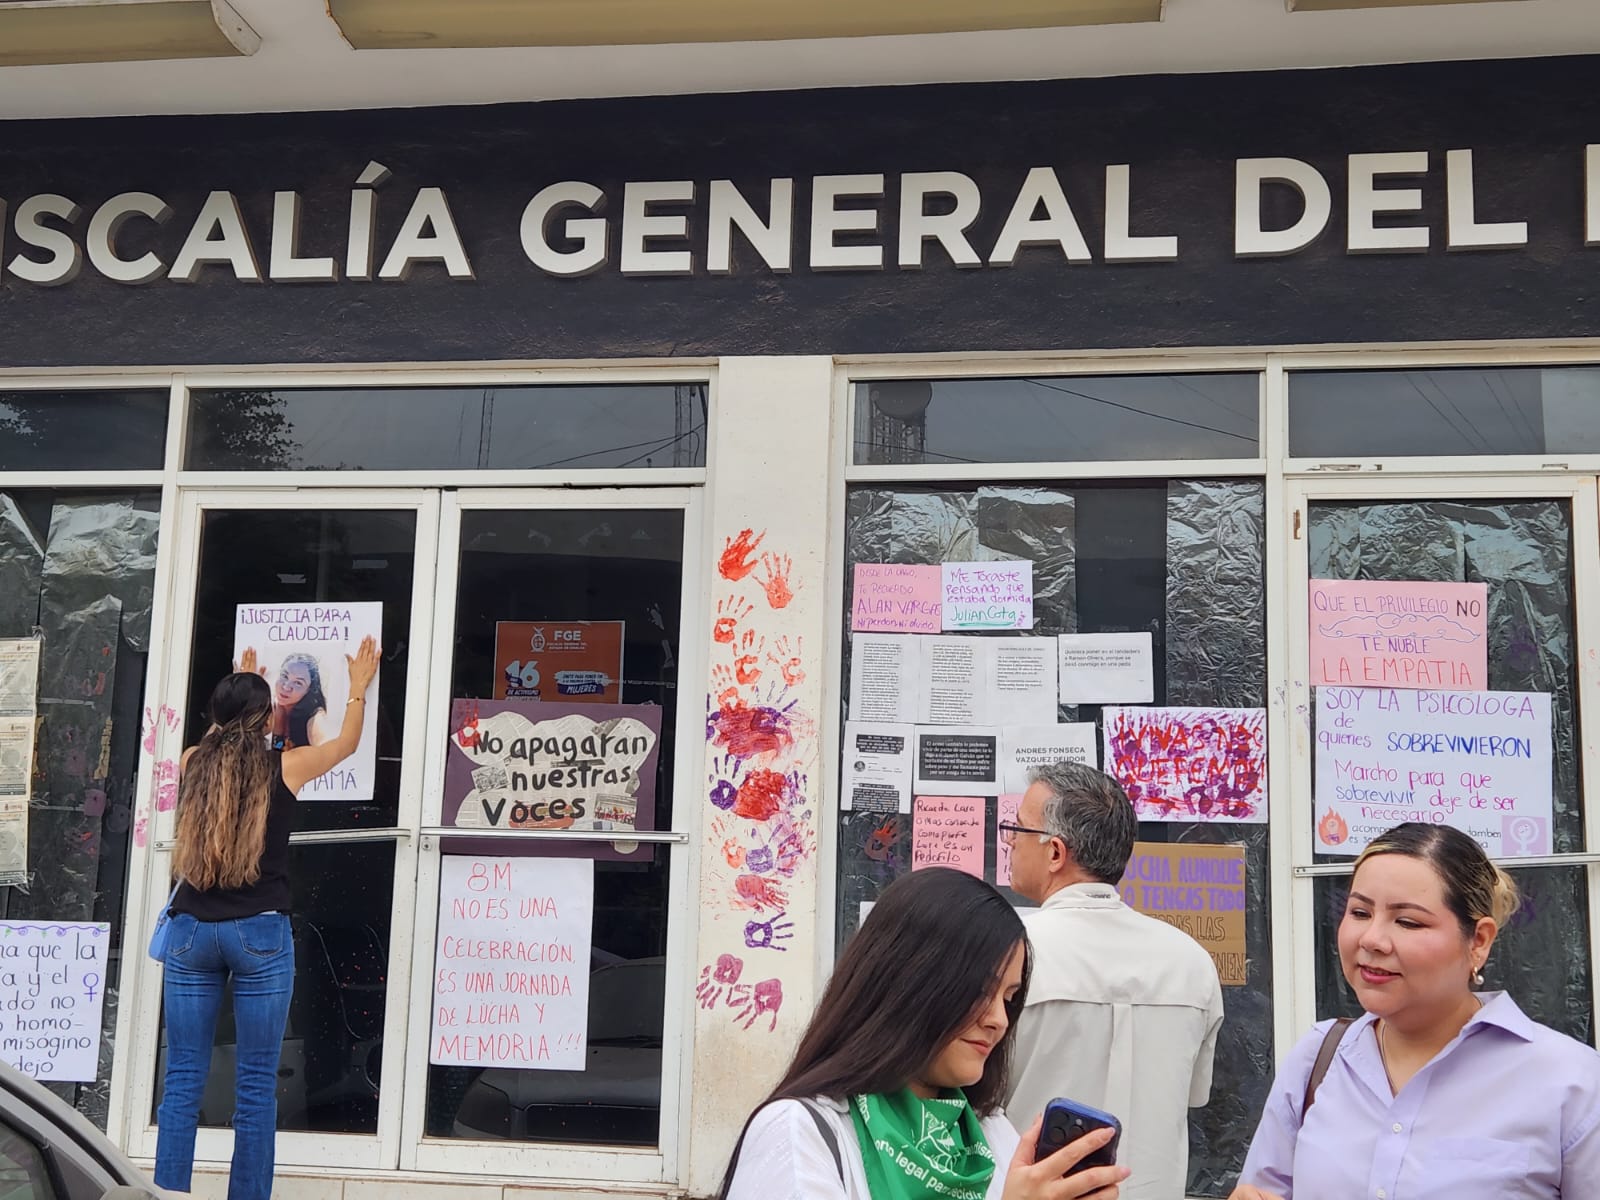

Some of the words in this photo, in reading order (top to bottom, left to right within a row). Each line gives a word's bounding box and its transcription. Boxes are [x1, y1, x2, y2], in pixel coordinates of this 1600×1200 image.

[0, 160, 475, 286] SCALÍA
[520, 163, 1179, 280] GENERAL
[1234, 148, 1528, 259] DEL
[315, 608, 351, 623] PARA
[858, 598, 892, 614] ALAN
[1314, 590, 1346, 612] QUE
[1354, 596, 1374, 612] EL
[1376, 595, 1448, 614] PRIVILEGIO
[1456, 600, 1481, 617] NO
[268, 626, 339, 641] CLAUDIA
[554, 631, 581, 641] FGE
[1357, 636, 1384, 651] TE
[1388, 638, 1431, 653] NUBLE
[505, 660, 540, 688] 16
[1322, 656, 1352, 683] LA
[1363, 656, 1472, 686] EMPATIA
[1326, 689, 1364, 711] SOY
[1378, 688, 1400, 712] LA
[1334, 712, 1355, 729] de
[474, 731, 503, 755] No
[1318, 731, 1371, 751] quienes
[1387, 732, 1531, 759] SOBREVIVIERON
[512, 765, 631, 791] nuestras
[1335, 759, 1398, 782] Marcho
[1409, 770, 1445, 790] para
[1460, 772, 1492, 793] que
[1335, 784, 1416, 805] sobrevivir
[1429, 790, 1461, 813] deje
[1469, 793, 1487, 810] de
[1493, 796, 1518, 811] ser
[1361, 806, 1445, 823] necesario
[467, 862, 512, 892] 8M
[453, 898, 481, 919] NO
[486, 898, 509, 919] ES
[520, 897, 558, 919] UNA
[1197, 916, 1226, 942] LAS
[28, 944, 62, 972] que
[75, 932, 96, 960] la
[28, 972, 41, 997] y
[51, 964, 68, 985] el
[437, 969, 456, 994] ES
[465, 972, 494, 993] UNA
[500, 972, 572, 996] JORNADA
[0, 990, 35, 1011] do
[50, 996, 75, 1009] no
[439, 1007, 458, 1027] DE
[466, 1004, 520, 1024] LUCHA
[535, 1003, 545, 1024] Y
[3, 1032, 91, 1058] misógino
[438, 1033, 550, 1061] MEMORIA
[895, 1151, 930, 1181] legal
